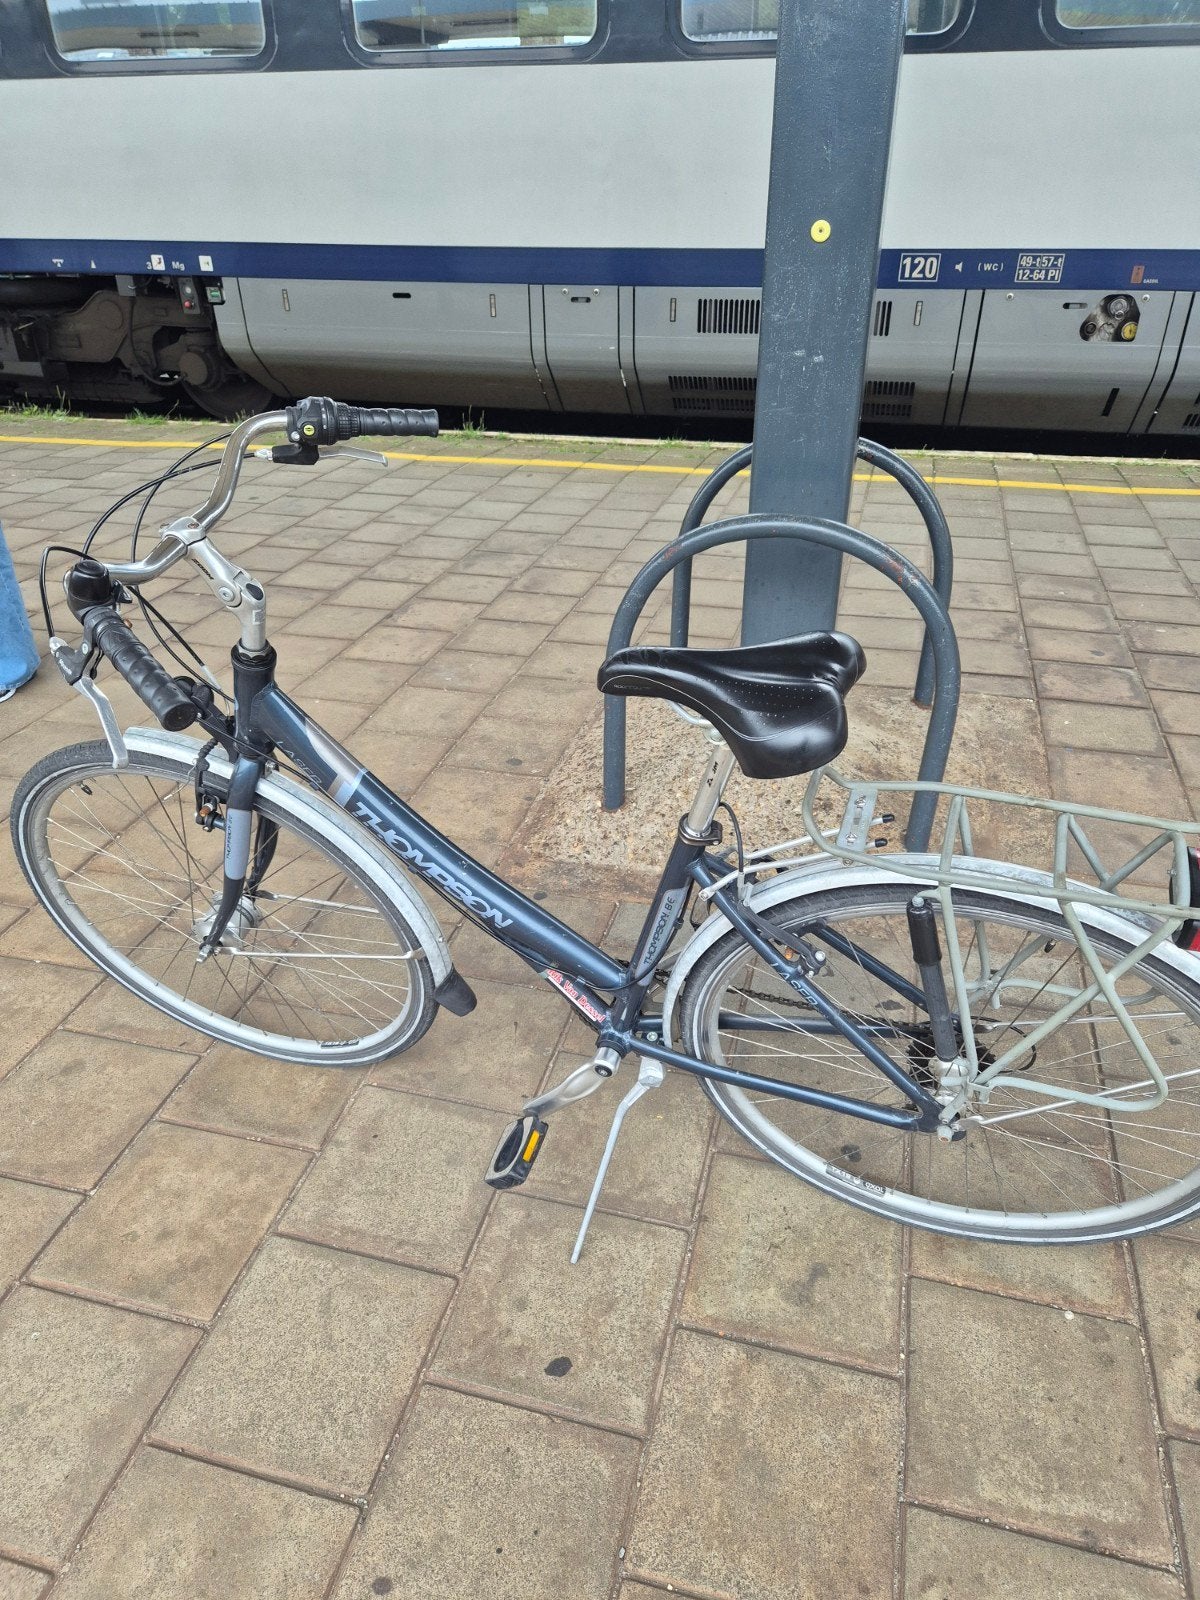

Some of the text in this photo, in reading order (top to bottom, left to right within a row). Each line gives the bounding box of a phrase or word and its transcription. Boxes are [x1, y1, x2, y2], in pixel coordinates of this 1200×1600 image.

[171, 261, 185, 271] Mg
[902, 257, 938, 279] 120
[977, 262, 1004, 272] (WC)
[1017, 269, 1045, 281] 12-64
[351, 801, 514, 929] THOMPSON
